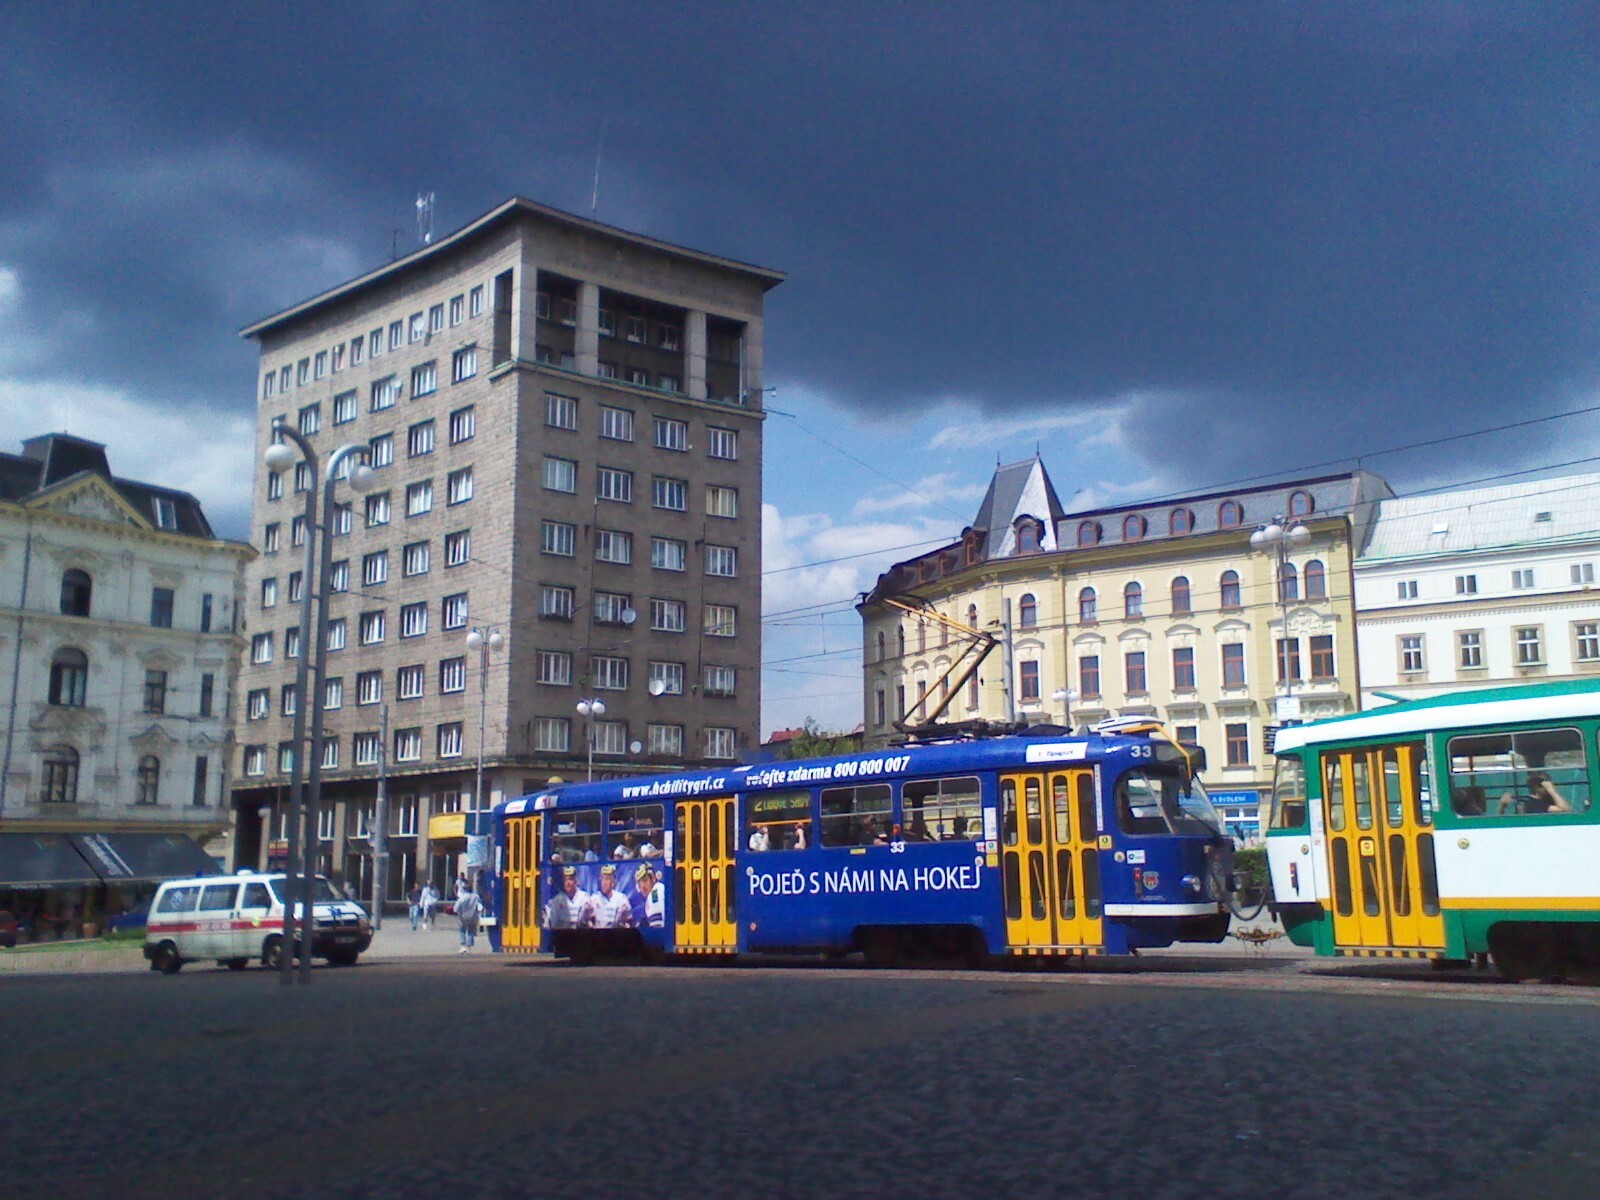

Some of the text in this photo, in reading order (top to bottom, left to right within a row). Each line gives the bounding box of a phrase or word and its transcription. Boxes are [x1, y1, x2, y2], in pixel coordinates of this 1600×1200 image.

[1131, 745, 1152, 758] 33
[787, 766, 831, 782] zdarma
[834, 762, 857, 778] 800
[859, 759, 883, 775] 800
[884, 756, 910, 773] 007
[890, 841, 905, 853] 33
[750, 865, 981, 895] POJEĎ S NÁMI NA HOKEJ
